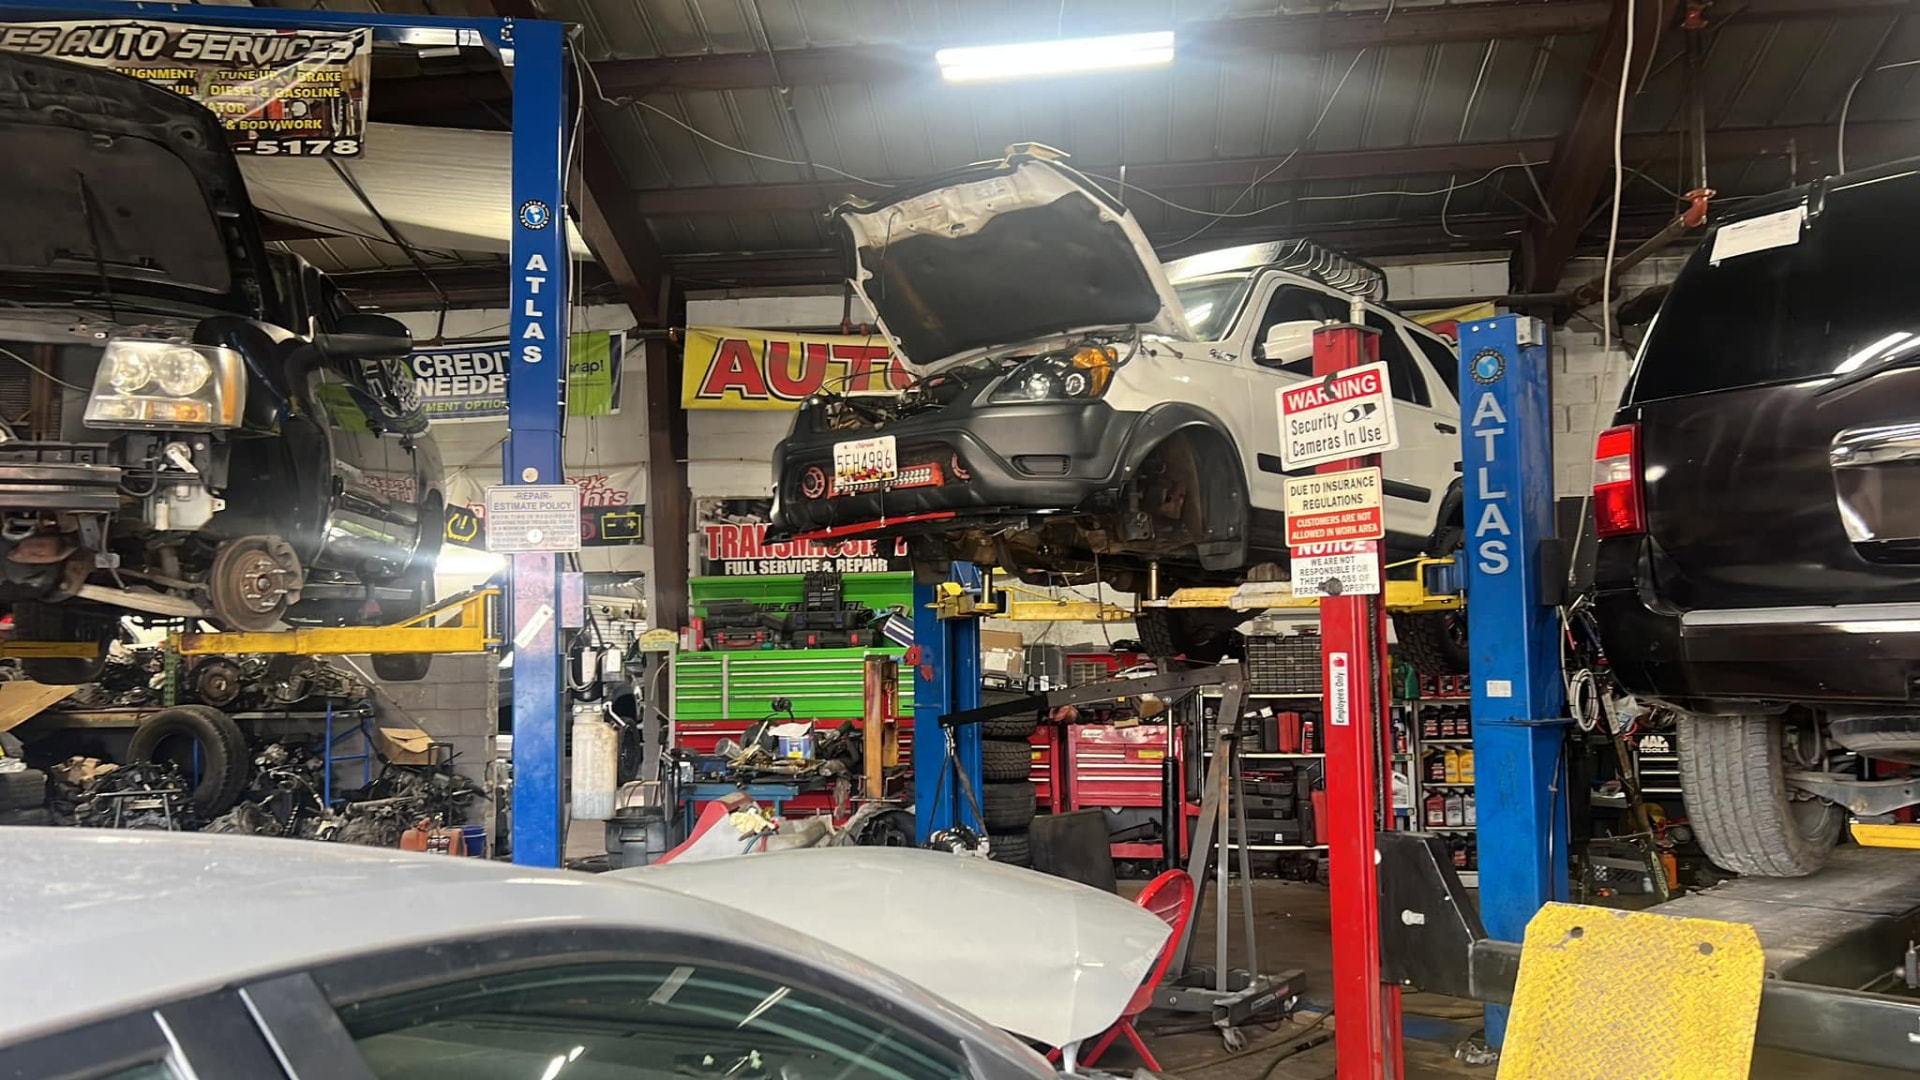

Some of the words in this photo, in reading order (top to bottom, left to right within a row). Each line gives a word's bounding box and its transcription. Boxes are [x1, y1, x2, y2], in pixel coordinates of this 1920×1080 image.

[0, 27, 61, 53] ES
[58, 25, 168, 60] AUTO
[172, 31, 355, 65] SERVICES
[297, 72, 342, 82] BRAKE
[210, 85, 257, 97] DIESEL
[259, 86, 270, 97] &
[275, 87, 341, 98] GASOLINE
[226, 120, 236, 130] &
[239, 120, 276, 130] BODY
[280, 119, 322, 129] WORK
[522, 254, 548, 363] ATLAS
[1291, 412, 1339, 436] Security
[1293, 436, 1341, 457] Cameras
[1344, 429, 1356, 446] In
[1360, 426, 1382, 443] Use
[1291, 485, 1309, 496] DUE
[1310, 483, 1321, 494] TO
[1323, 476, 1374, 492] INSURANCE
[1471, 391, 1512, 575] ATLAS
[494, 502, 537, 510] ESTIMATE
[540, 502, 572, 510] POLICY
[1303, 493, 1363, 510] REGULATIONS
[1296, 515, 1340, 528] CUSTOMERS
[1341, 513, 1356, 523] ARE
[1356, 511, 1371, 521] NOT
[1291, 528, 1325, 540] ALLOWED
[1326, 528, 1334, 536] IN
[1335, 526, 1357, 536] WORK
[1358, 523, 1378, 532] AREA
[725, 561, 757, 575] FULL
[759, 559, 820, 575] SERVICE
[822, 561, 834, 573] &
[836, 558, 888, 573] REPAIR
[1324, 557, 1338, 565] ARE
[1339, 556, 1355, 564] NOT
[1300, 566, 1350, 576] RESPONSIBLE
[1351, 565, 1368, 573] FOR
[1359, 574, 1370, 582] OF
[1335, 672, 1345, 687] Only
[1336, 689, 1346, 723] Employees
[1639, 735, 1669, 747] MAC
